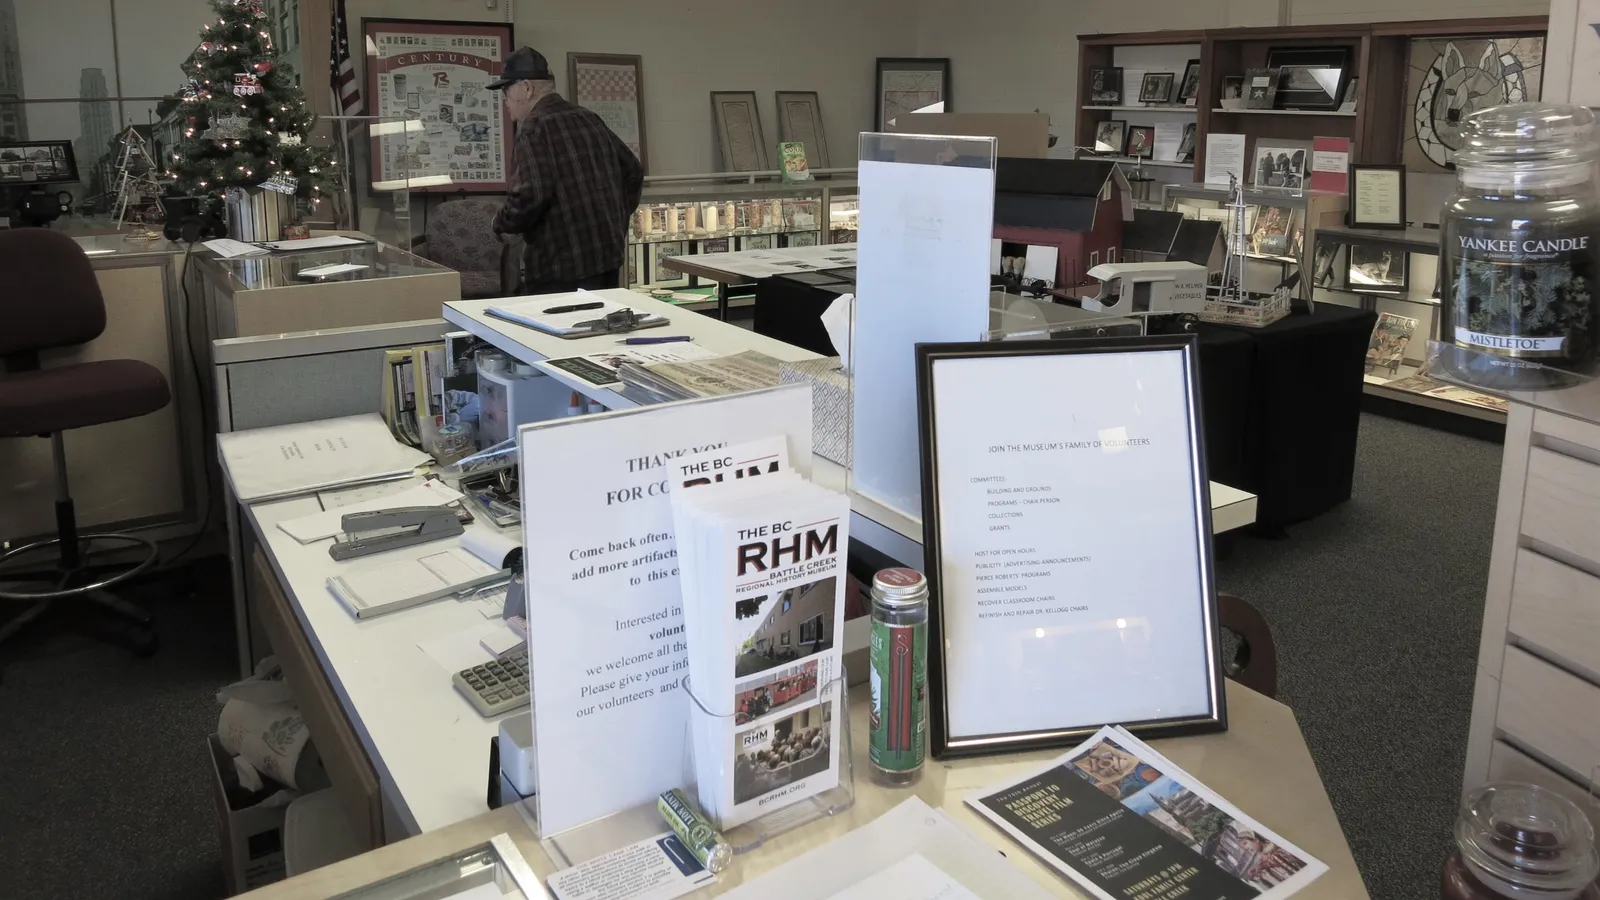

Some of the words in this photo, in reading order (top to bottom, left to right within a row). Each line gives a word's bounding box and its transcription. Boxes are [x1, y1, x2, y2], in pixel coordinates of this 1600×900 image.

[398, 53, 482, 66] CENTURY
[1459, 235, 1517, 252] YANKEE
[1522, 236, 1590, 253] CANDLE
[1469, 333, 1543, 350] MISTLETOE
[989, 445, 1006, 453] JOIN
[1007, 444, 1021, 452] THE
[1023, 442, 1064, 451] MUSEUM'S
[1065, 440, 1091, 449] FAMILY
[1093, 440, 1102, 448] OF
[1103, 438, 1150, 448] VOLUNTEERS
[681, 461, 709, 476] THE
[713, 457, 733, 469] BC
[606, 486, 643, 506] FOR
[737, 526, 768, 540] THE
[772, 521, 792, 534] BC
[569, 547, 604, 561] Come
[608, 538, 636, 553] back
[737, 524, 838, 577] RHM
[572, 566, 594, 581] add
[599, 561, 629, 574] more
[632, 548, 678, 567] artifacts
[769, 565, 805, 580] BATTLE
[807, 557, 837, 570] CREEK
[975, 561, 1001, 569] PUBLICITY
[630, 577, 641, 586] to
[648, 568, 668, 581] this
[736, 581, 774, 593] REGIONAL
[776, 573, 806, 585] HISTORY
[808, 564, 837, 575] MUSEUM
[977, 586, 1004, 594] ASSEMBLE
[1003, 597, 1035, 605] CLASSROOM
[1045, 606, 1069, 614] KELLOGG
[615, 607, 668, 631] Interested
[671, 605, 681, 617] in
[649, 623, 686, 640] volunt
[586, 666, 602, 677] we
[605, 651, 654, 671] welcome
[657, 645, 670, 658] all
[581, 680, 616, 698] Please
[619, 672, 642, 689] give
[645, 666, 670, 682] your
[576, 706, 596, 718] our
[598, 688, 655, 711] volunteers
[660, 678, 679, 693] and
[744, 730, 768, 745] RHM
[758, 782, 806, 806] BCRHM.ORG
[1003, 788, 1050, 810] PASSPORT
[1044, 783, 1061, 793] TO
[1012, 793, 1061, 816] DISCOVERY
[1020, 805, 1056, 823] TRAVEL
[1050, 796, 1075, 810] FILM
[1029, 812, 1063, 829] SERIES
[1123, 874, 1162, 895] SATURDAYS
[1150, 879, 1175, 895] FAMILY
[1172, 866, 1199, 882] CENTER
